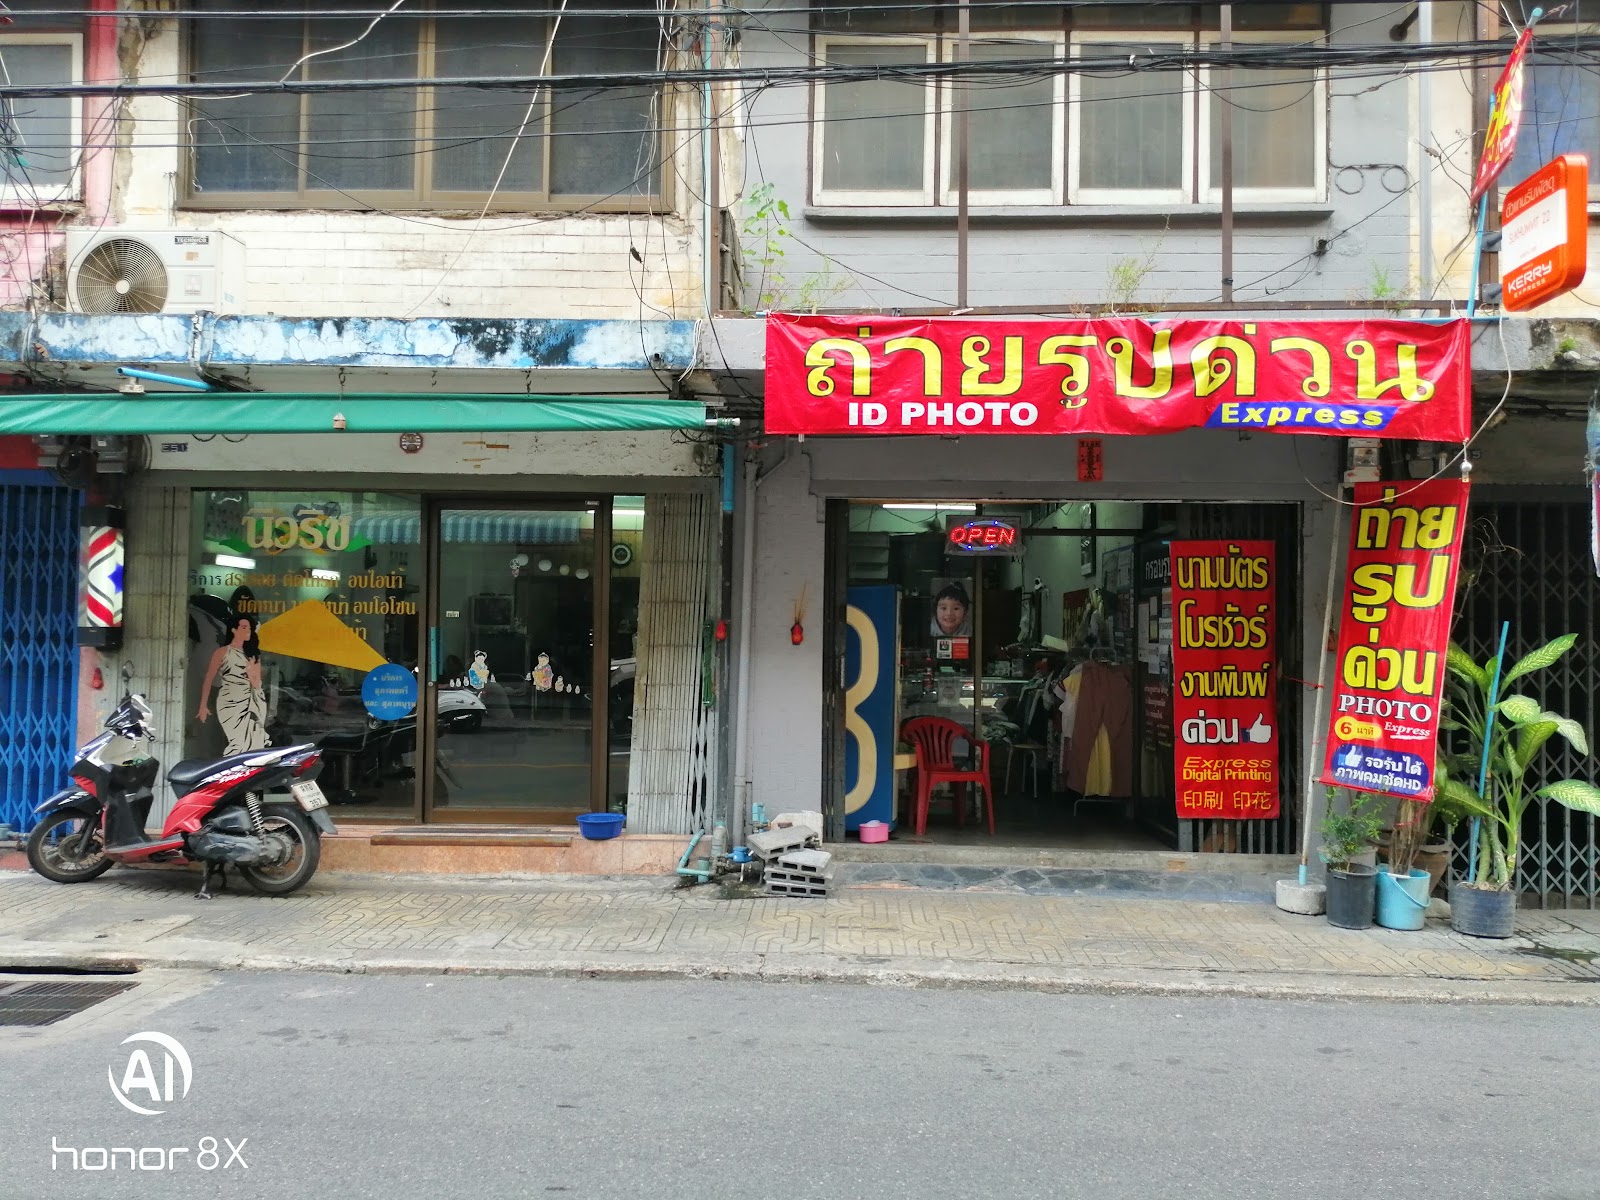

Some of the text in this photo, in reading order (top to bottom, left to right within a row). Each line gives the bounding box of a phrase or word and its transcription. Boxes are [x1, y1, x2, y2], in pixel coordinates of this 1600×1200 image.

[1542, 210, 1551, 225] 22
[1508, 260, 1553, 294] KERRY
[1513, 277, 1547, 299] EXPRESS
[805, 325, 1435, 409] ถ่ายรูปด่วน
[848, 401, 1386, 428] ID PHOTO Express
[241, 508, 352, 551] นิวริช
[1355, 488, 1457, 550] ถ่าย
[950, 525, 1016, 545] OPEN
[189, 569, 222, 587] ริการ
[348, 567, 407, 589] อบไอน้ำ
[1176, 544, 1269, 590] นามบัตร
[1351, 555, 1450, 623] รูป
[1179, 599, 1268, 649] โบรชัวร์
[1342, 628, 1438, 697] ด่วน
[1180, 663, 1270, 698] งานพิมพ์
[1338, 694, 1432, 722] PHOTO
[1181, 709, 1239, 744] ด่วน
[1339, 721, 1375, 736] 6 นาที
[1384, 721, 1431, 737] Express
[1183, 756, 1272, 768] Express
[1183, 768, 1272, 783] Digital Printing
[1365, 753, 1422, 776] รอรับได้
[1183, 790, 1272, 810] 印刷 印花
